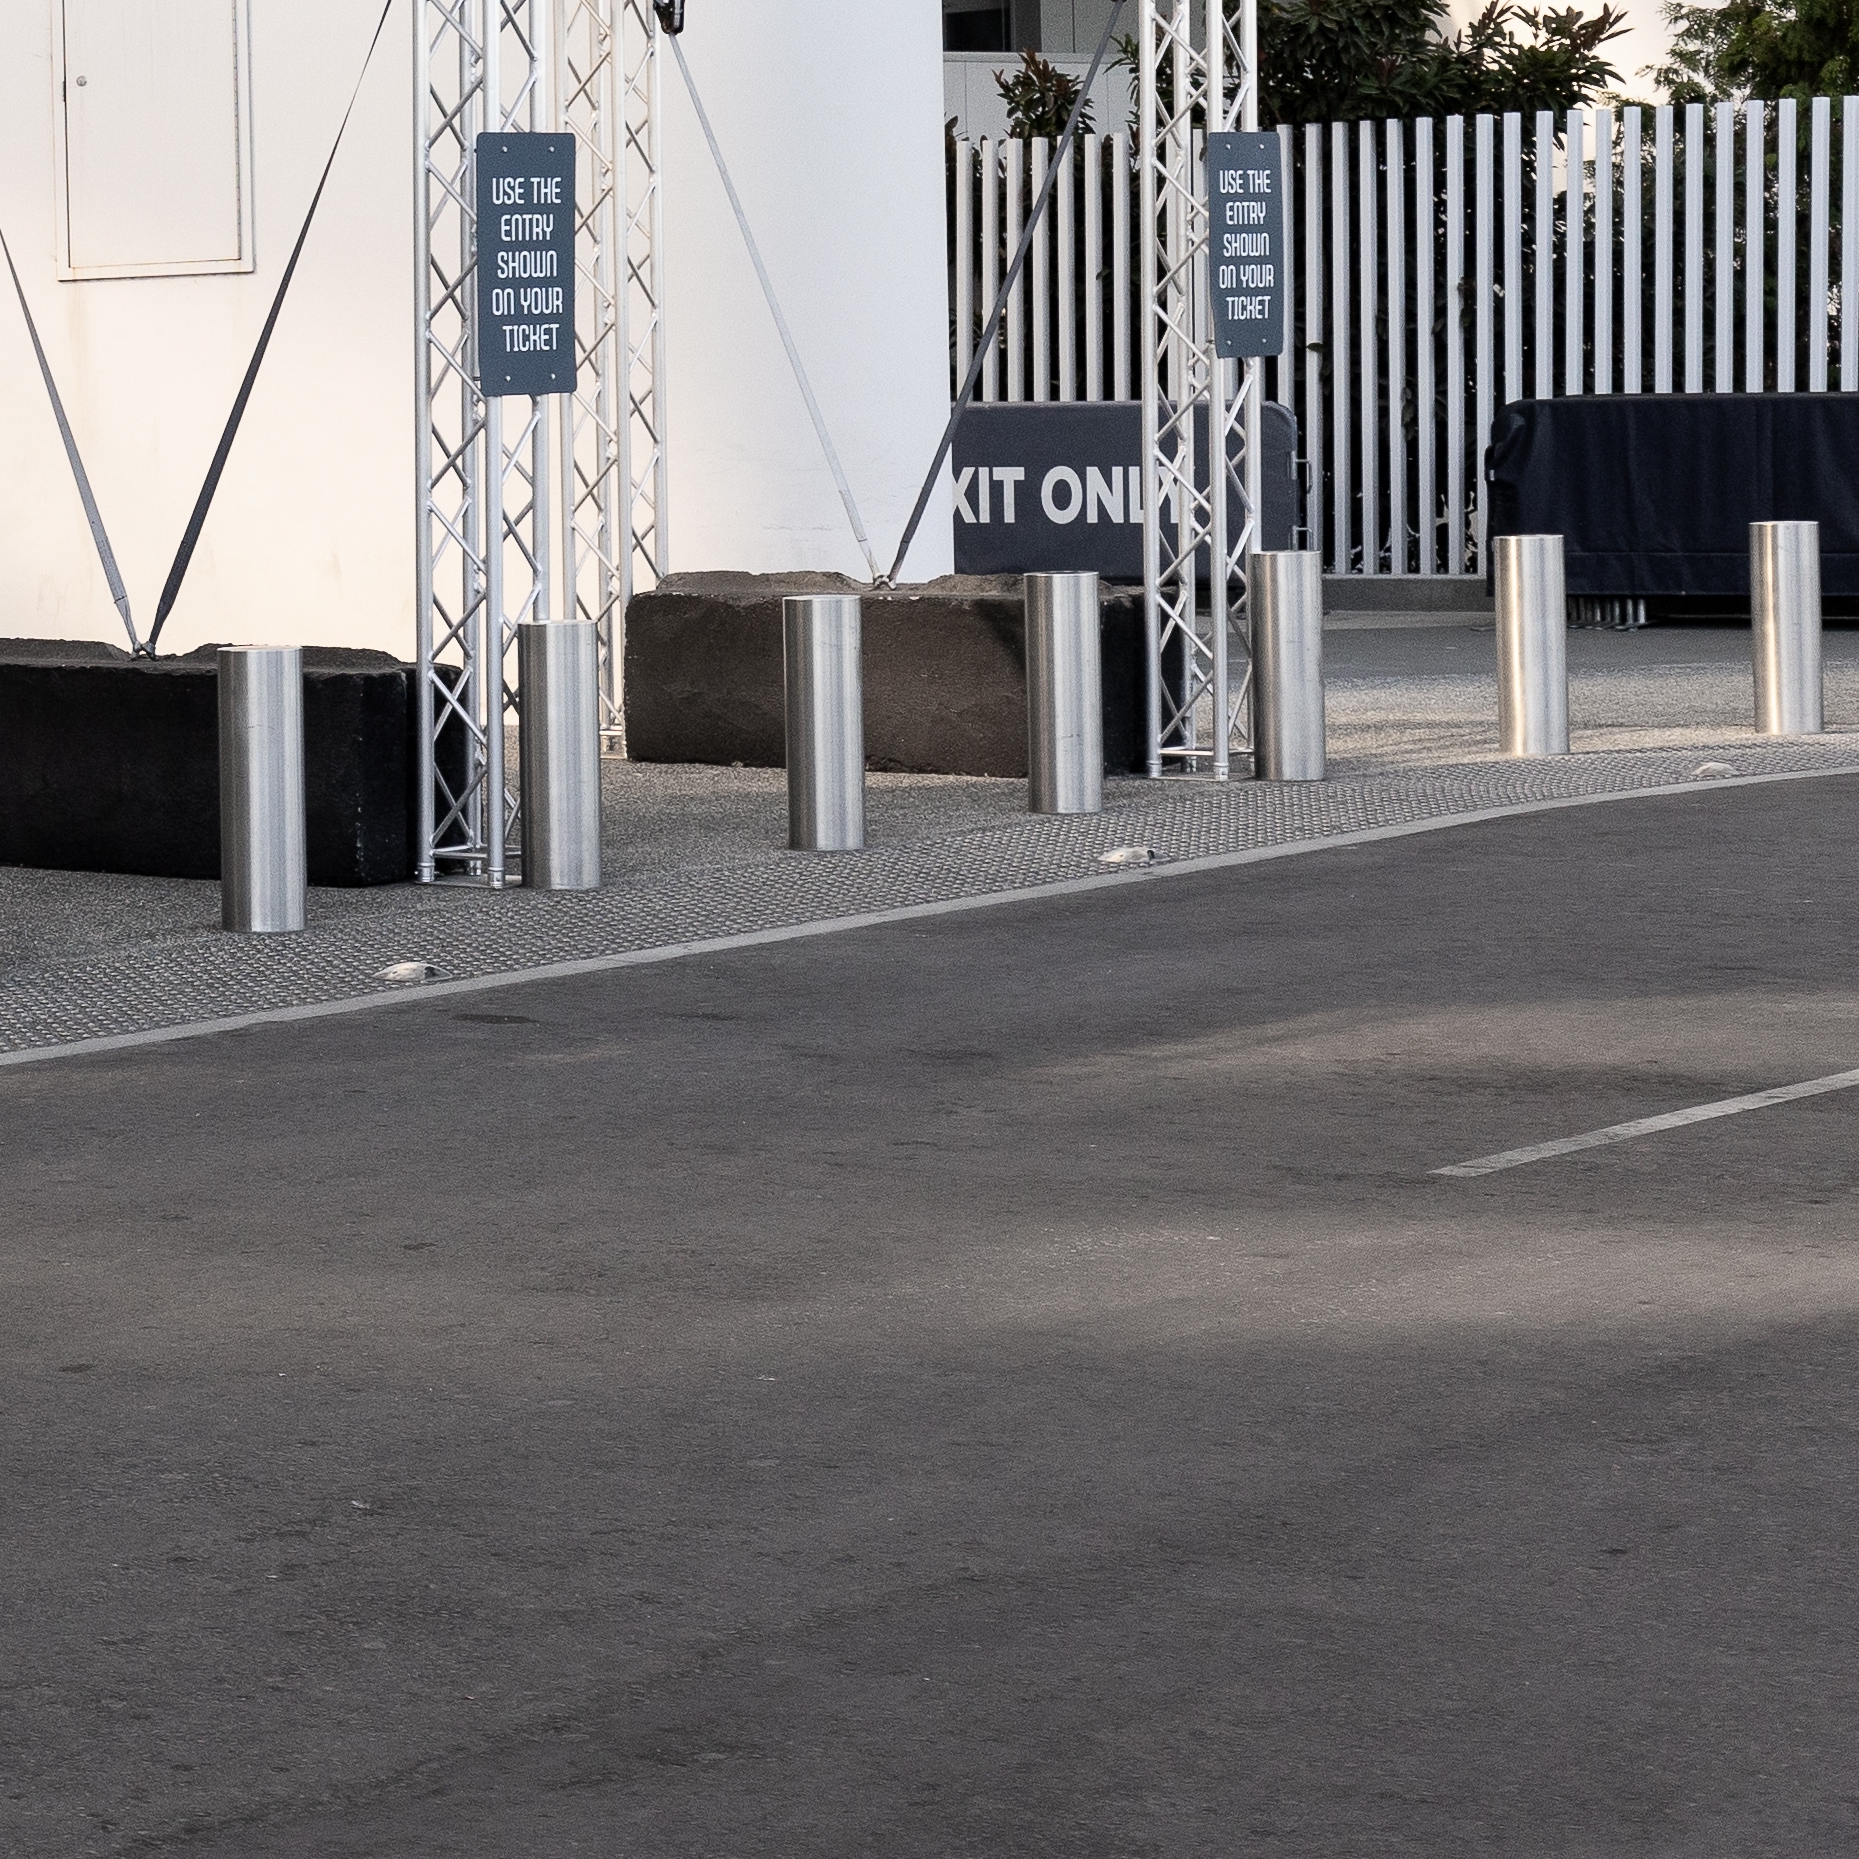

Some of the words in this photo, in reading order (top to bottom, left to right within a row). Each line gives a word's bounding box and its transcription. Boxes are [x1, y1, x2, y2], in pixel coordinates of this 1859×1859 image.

[493, 177, 525, 204] USE
[530, 177, 562, 204] THE
[1220, 170, 1244, 194] USE
[1247, 170, 1271, 194] THE
[1226, 201, 1266, 225] ENTRY
[501, 214, 553, 241] ENTRY
[1223, 233, 1270, 258] SHOWN
[498, 251, 558, 279] SHOWN
[1220, 265, 1237, 289] ON
[1239, 265, 1275, 289] YOUR
[493, 288, 514, 316] ON
[520, 287, 563, 315] YOUR
[1226, 296, 1272, 321] TICKET
[502, 324, 560, 352] TICKET
[952, 466, 1025, 524] XIT
